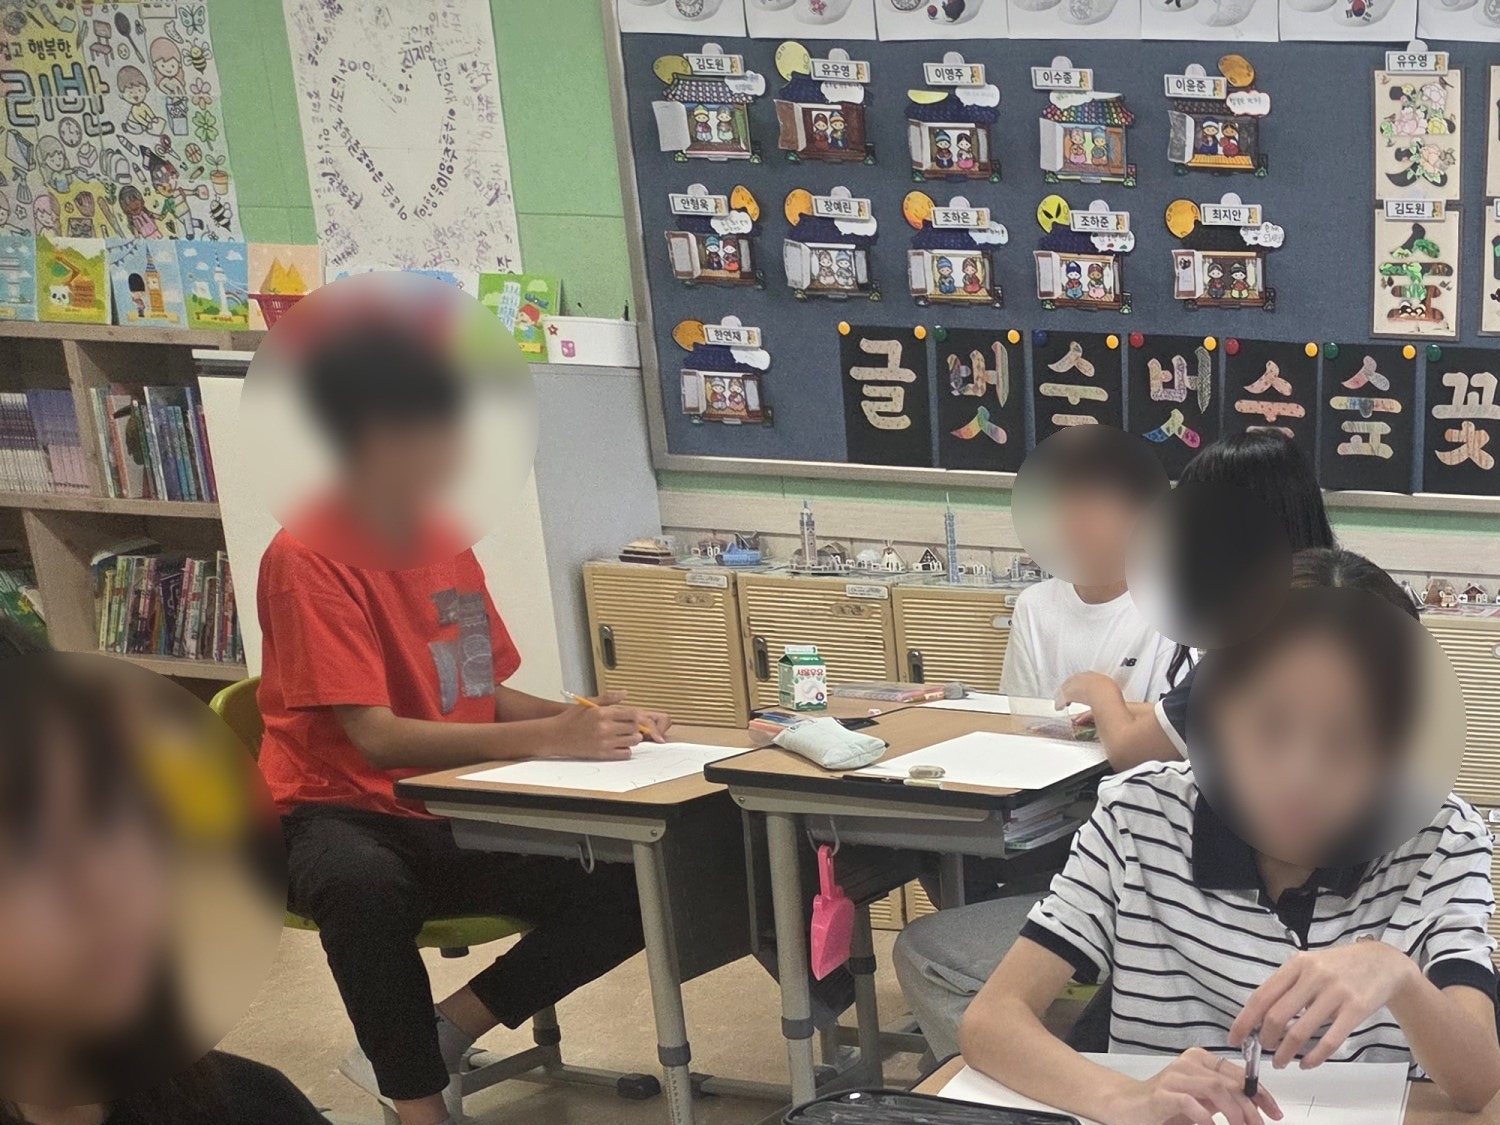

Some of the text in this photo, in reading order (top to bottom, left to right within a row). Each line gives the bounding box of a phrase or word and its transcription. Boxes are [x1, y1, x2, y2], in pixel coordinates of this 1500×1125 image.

[28, 38, 72, 60] 행복한
[695, 58, 725, 70] 김도원
[1397, 54, 1428, 67] 유우영
[821, 63, 850, 77] 유우영
[935, 67, 964, 81] 이영주
[1042, 71, 1072, 85] 이수종
[1176, 78, 1206, 93] 이윤준
[0, 62, 115, 137] 리반
[681, 198, 708, 211] 안형욱
[824, 200, 851, 214] 장예린
[1394, 203, 1425, 215] 김도원
[942, 211, 970, 224] 조하은
[1080, 215, 1109, 228] 조하준
[1212, 208, 1242, 222] 최지안
[850, 337, 916, 430] 글
[946, 341, 1009, 444] 벗
[1141, 346, 1211, 448] 벗
